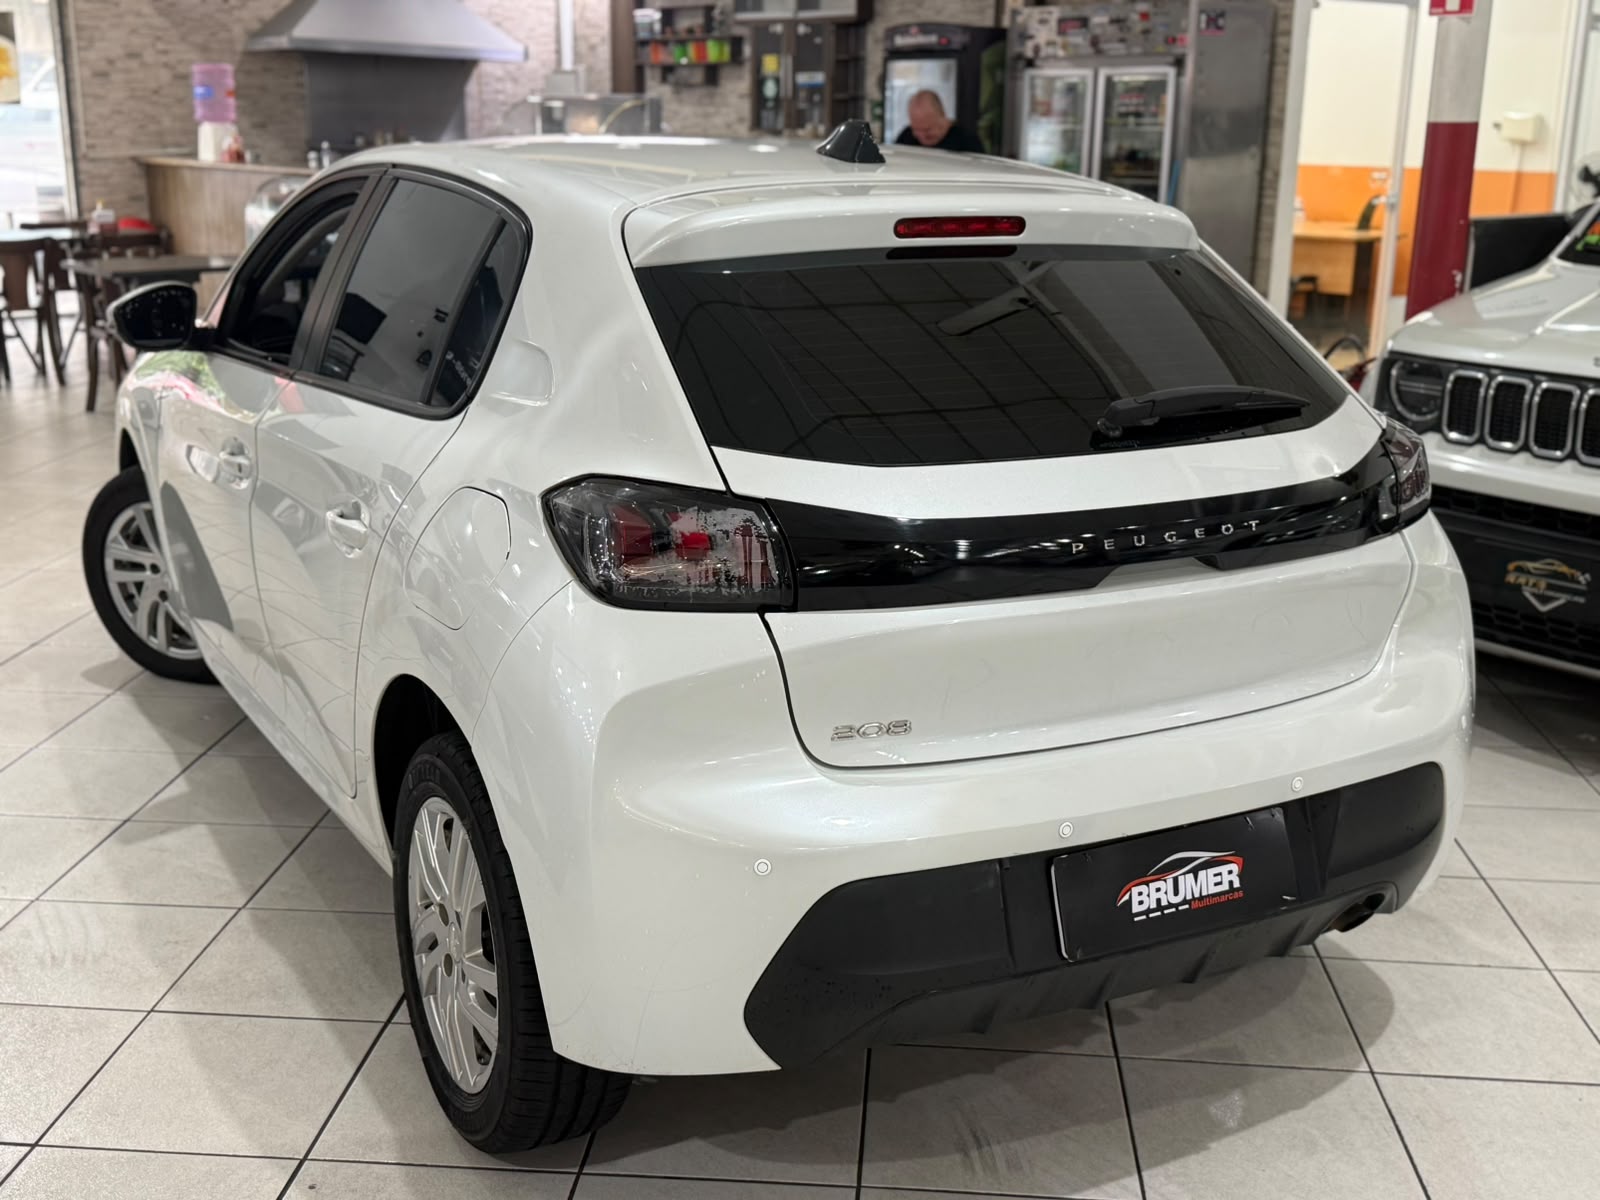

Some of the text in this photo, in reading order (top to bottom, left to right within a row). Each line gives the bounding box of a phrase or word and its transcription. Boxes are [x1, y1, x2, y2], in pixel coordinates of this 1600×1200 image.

[1071, 519, 1260, 555] PEUGEOT
[830, 719, 912, 742] 208
[1131, 862, 1241, 914] BRUMER
[1191, 889, 1244, 910] Multimarcas
